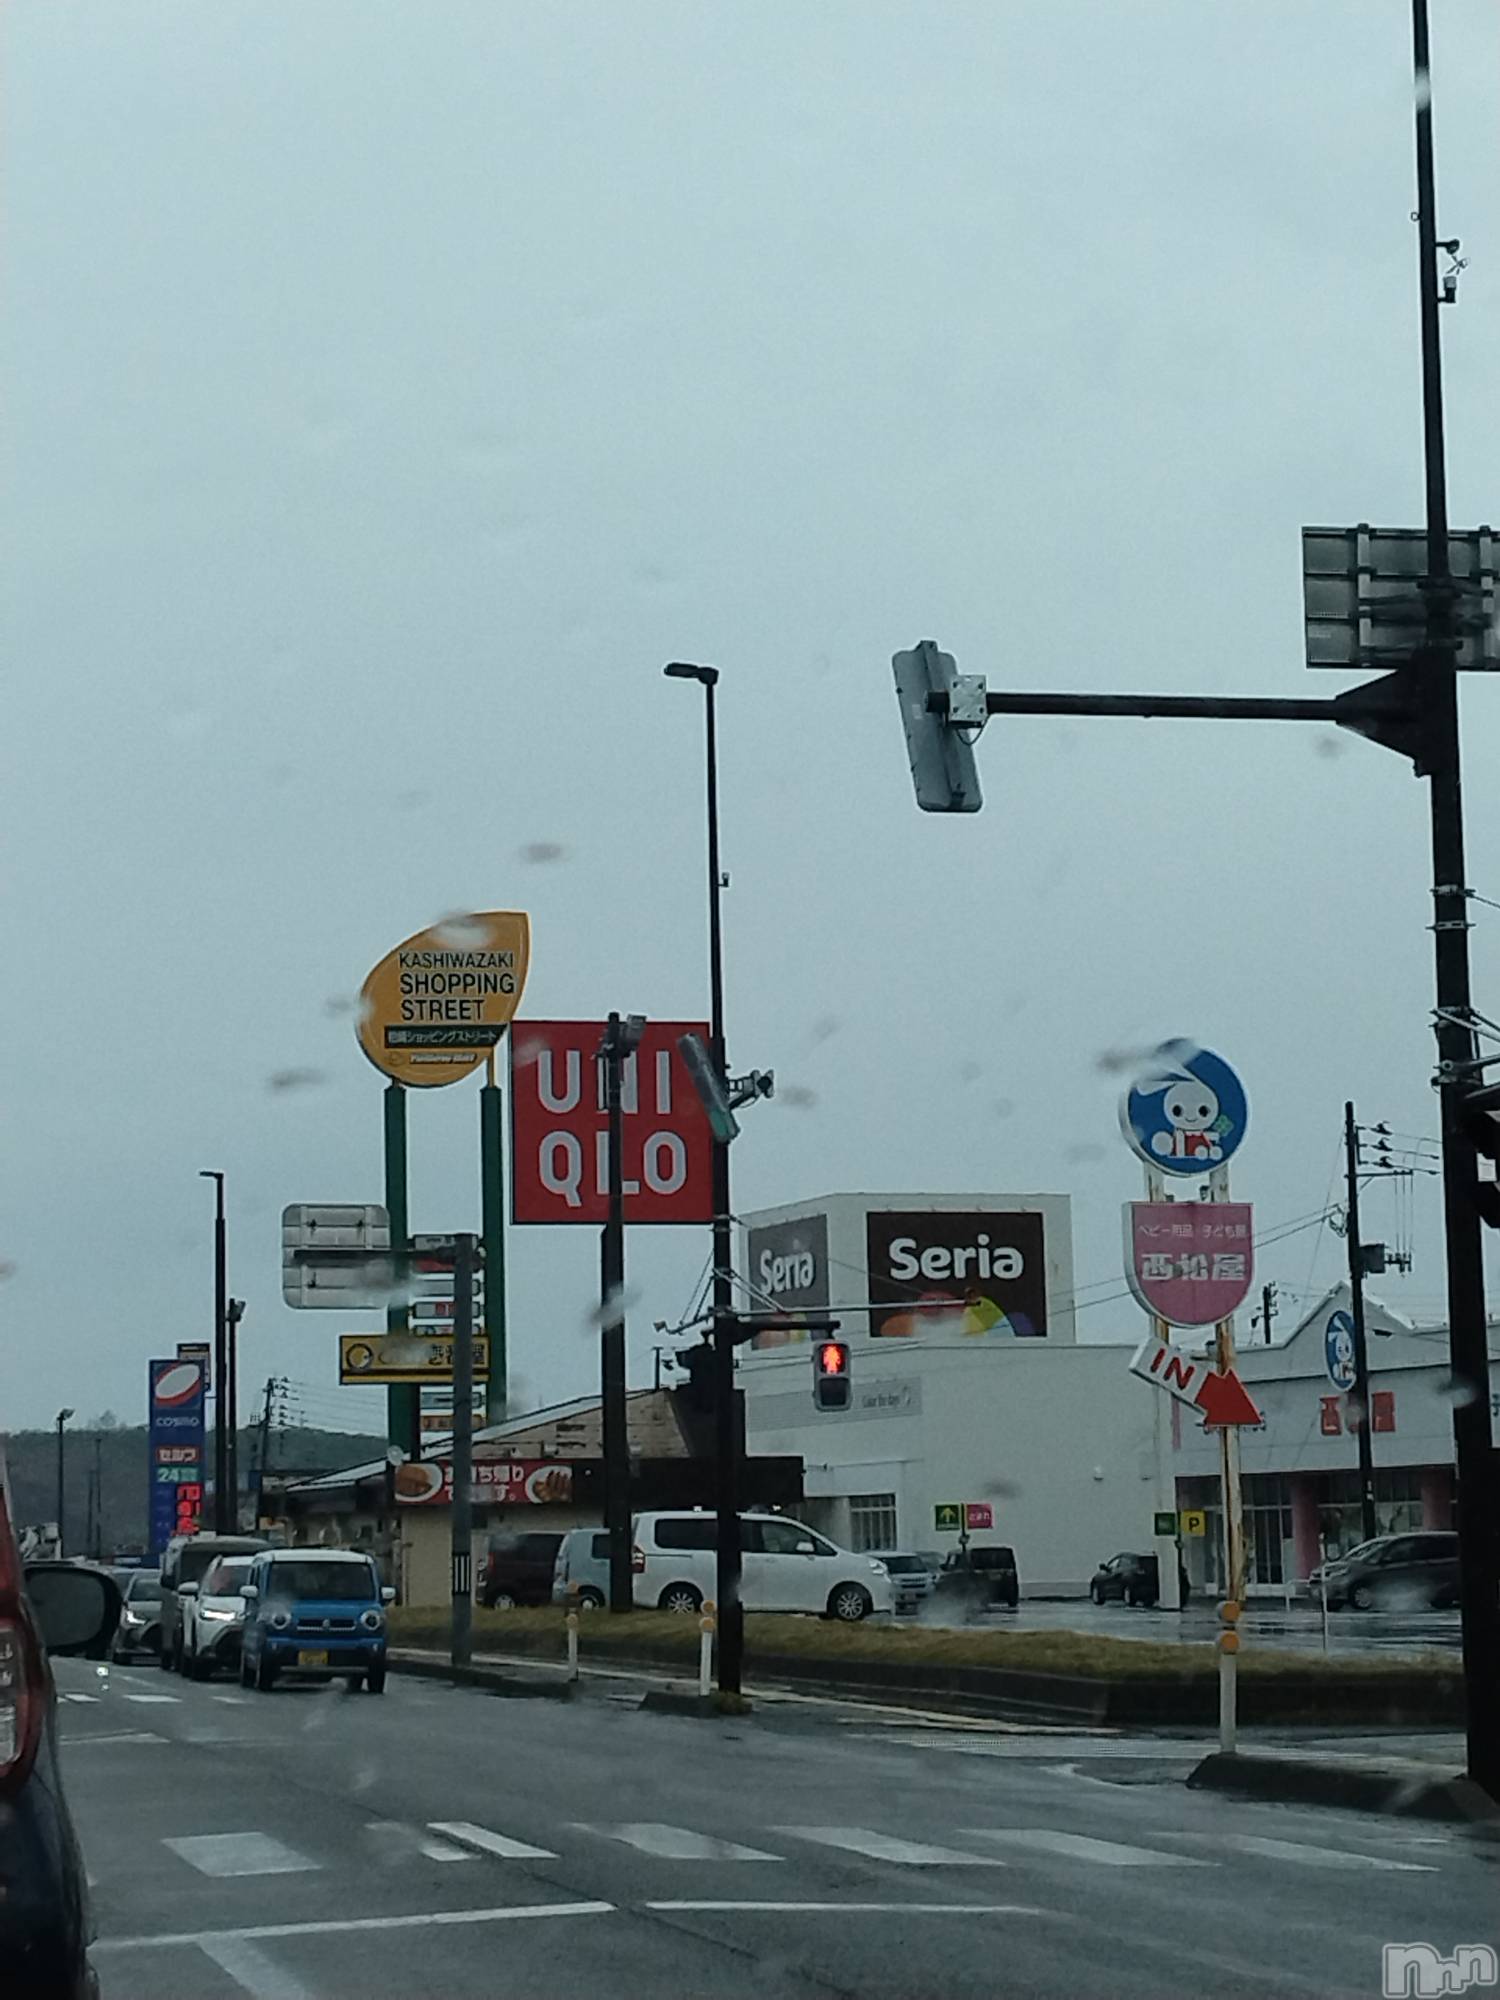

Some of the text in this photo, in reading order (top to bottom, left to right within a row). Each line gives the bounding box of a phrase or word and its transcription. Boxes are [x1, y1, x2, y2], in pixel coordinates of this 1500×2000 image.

[399, 952, 514, 968] KASHIWAZAKI
[400, 973, 515, 995] SHOPPING
[401, 999, 485, 1021] STREET
[537, 1050, 671, 1115] UNI
[539, 1130, 687, 1207] QLO
[889, 1233, 1024, 1281] Seria
[1141, 1253, 1246, 1281] 西松屋
[1150, 1347, 1196, 1390] IN
[1189, 1517, 1200, 1533] P
